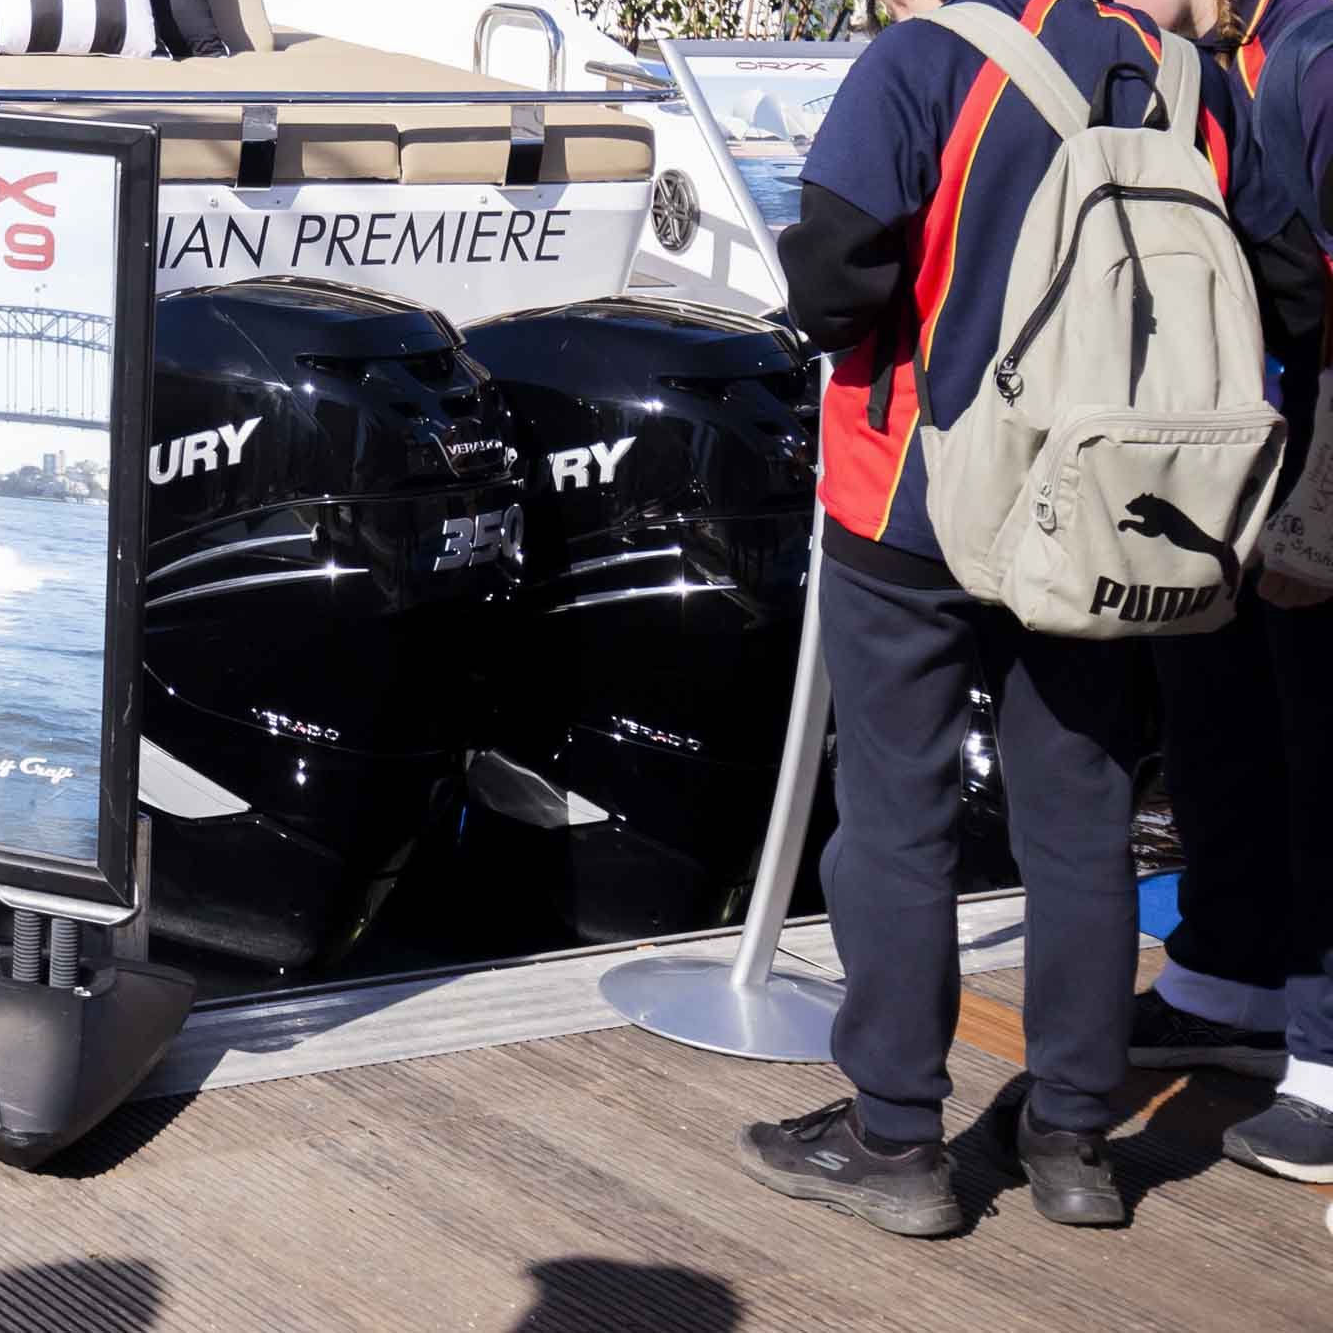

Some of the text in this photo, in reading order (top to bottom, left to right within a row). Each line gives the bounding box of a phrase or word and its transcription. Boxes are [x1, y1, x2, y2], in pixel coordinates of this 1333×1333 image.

[735, 61, 828, 72] ORYX
[291, 210, 572, 267] PREMIERE
[547, 435, 638, 493] RY
[433, 503, 525, 572] 350
[19, 757, 76, 785] Craft
